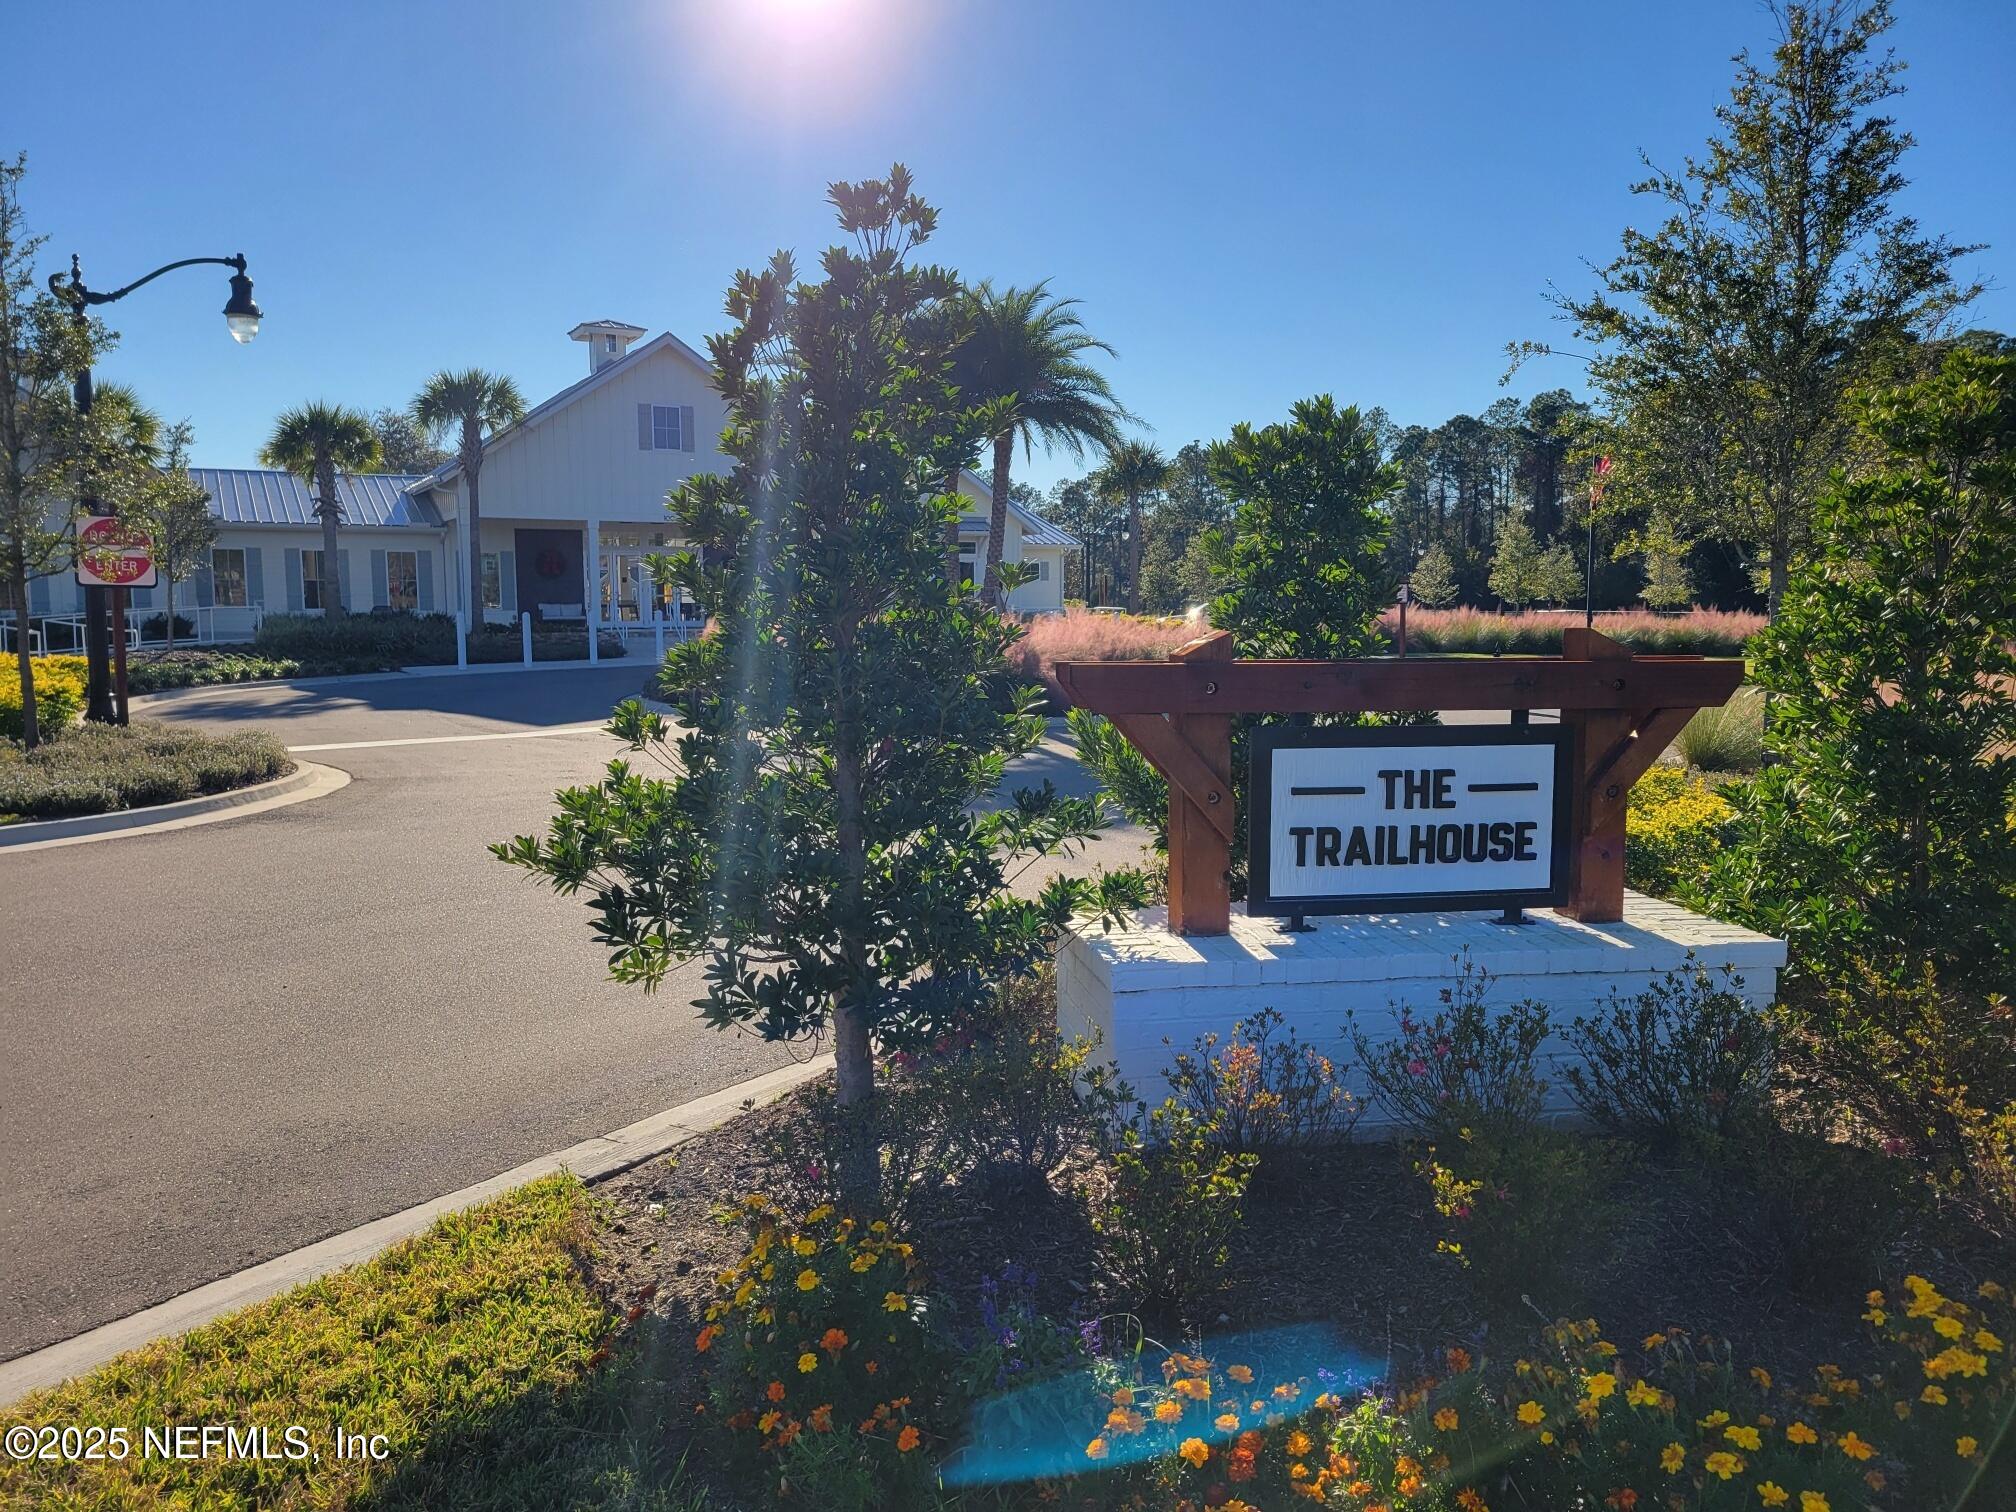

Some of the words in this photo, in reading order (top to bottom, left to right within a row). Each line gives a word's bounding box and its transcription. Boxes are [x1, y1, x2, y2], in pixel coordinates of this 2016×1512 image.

[96, 560, 137, 571] ENTER
[1377, 769, 1456, 810] THE
[1289, 822, 1537, 867] TRAILHOUSE
